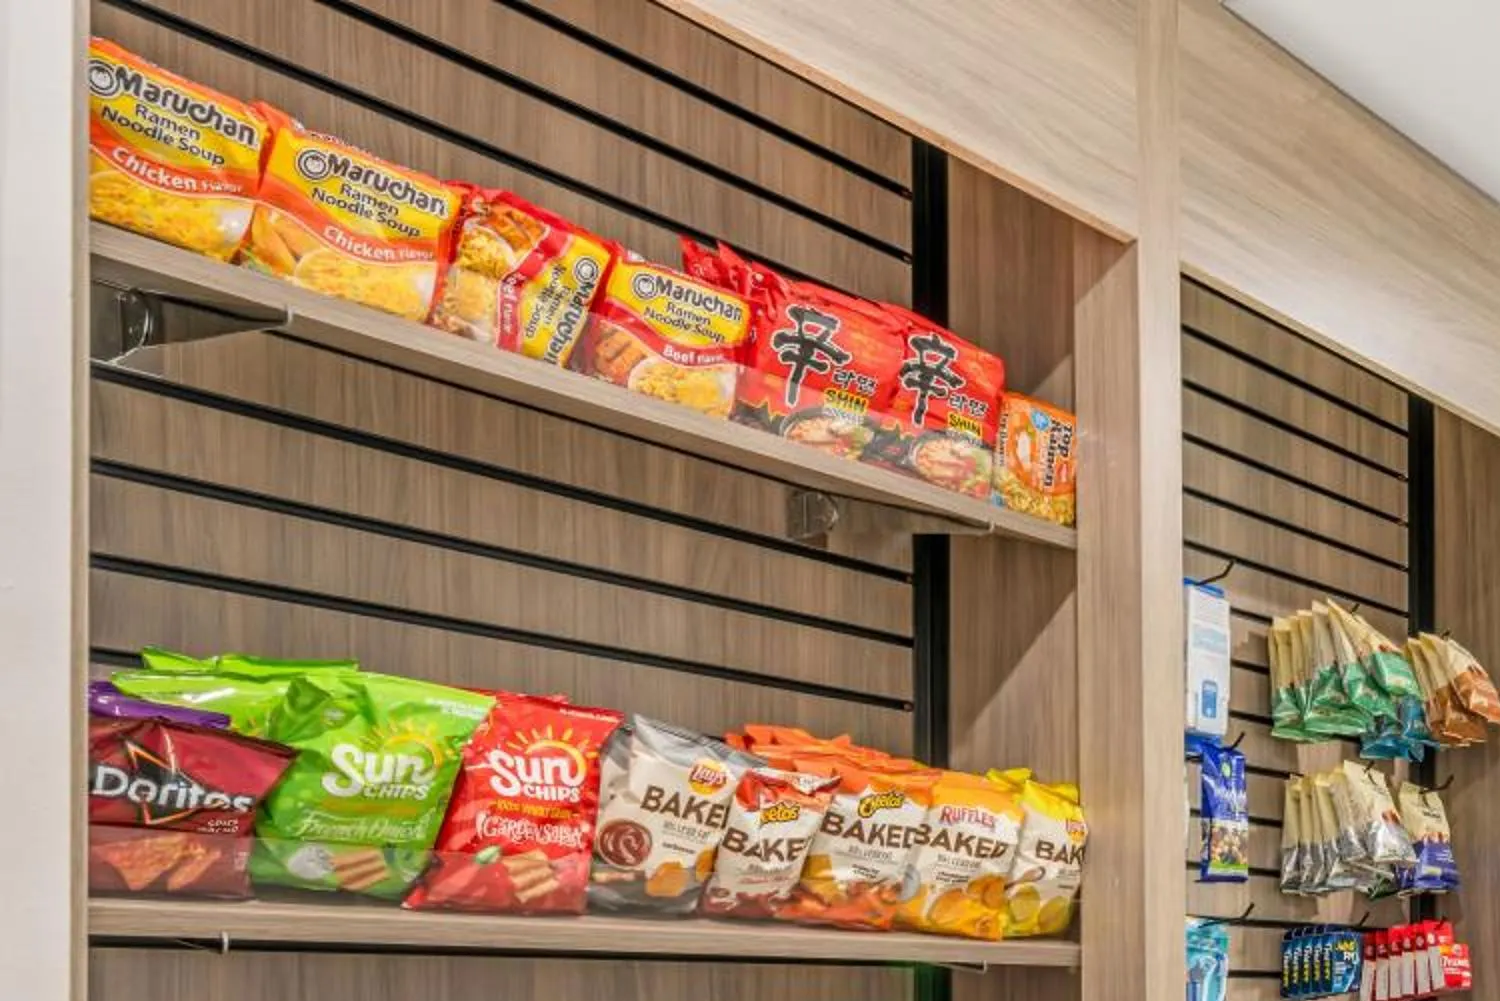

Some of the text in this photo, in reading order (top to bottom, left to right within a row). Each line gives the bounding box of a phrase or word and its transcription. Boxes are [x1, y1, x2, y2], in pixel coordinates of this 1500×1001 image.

[114, 66, 258, 150] Maruchan
[135, 104, 200, 140] Ramen
[101, 106, 225, 167] Noodle Soup
[112, 147, 198, 191] Chicken
[327, 153, 449, 218] Maruchan
[311, 186, 421, 239] Noodle Soup
[340, 183, 399, 215] Ramen
[323, 224, 396, 261] Chicken
[655, 274, 743, 320] Maruchan
[665, 302, 711, 326] Ramen
[644, 306, 726, 343] Noodle Soup
[93, 764, 254, 814] Doritos
[322, 743, 438, 798] Sun
[363, 784, 433, 800] CHIPS
[488, 749, 584, 797] Sun
[524, 783, 580, 803] CHIPS
[941, 806, 996, 829] RUFFLES
